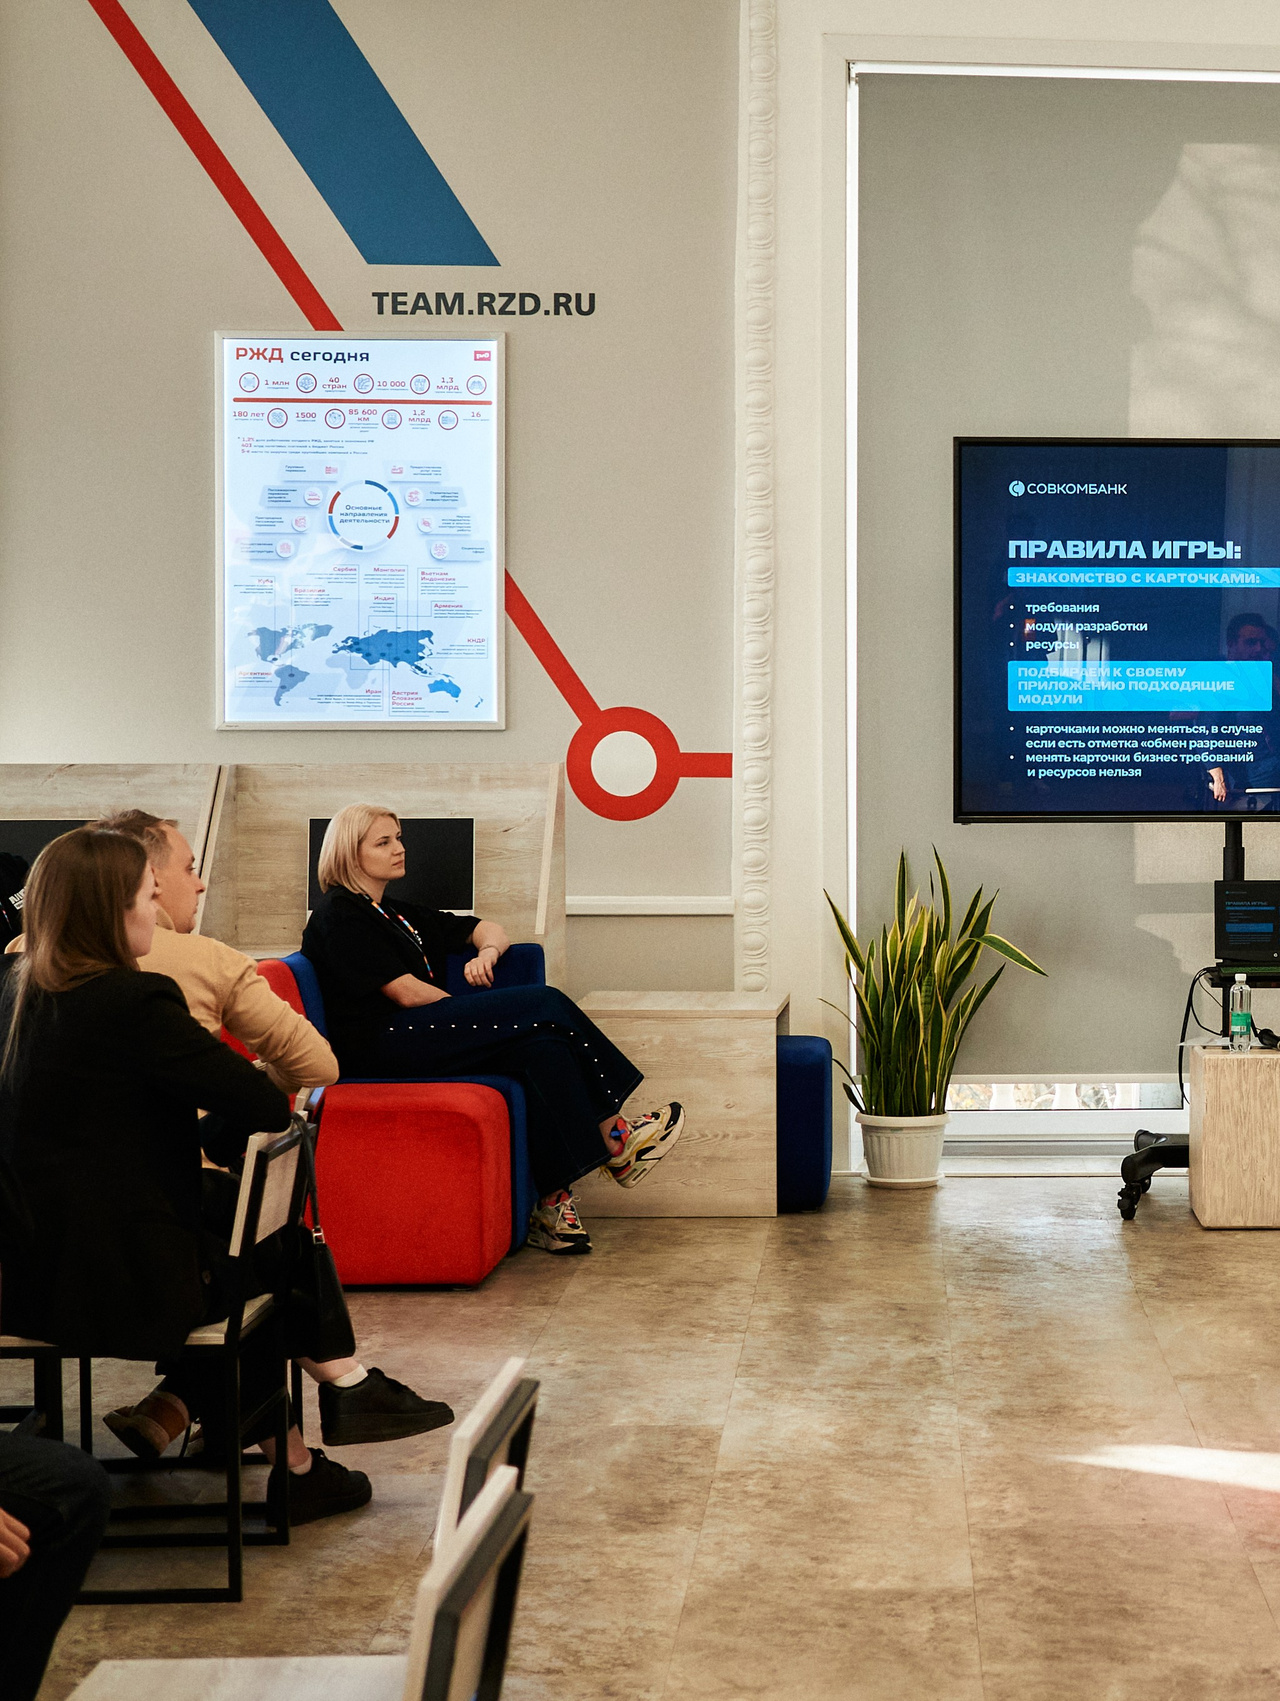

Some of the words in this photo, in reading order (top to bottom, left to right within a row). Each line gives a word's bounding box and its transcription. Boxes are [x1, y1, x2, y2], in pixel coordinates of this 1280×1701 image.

[371, 291, 596, 316] TEAM.RZD.RU
[235, 347, 284, 363] РЖД
[290, 351, 369, 364] сегодня
[1027, 483, 1128, 495] СОВКОМБАНК
[1008, 540, 1147, 559] ПРАВИЛА
[1152, 540, 1241, 560] ИГРЫ:
[1015, 572, 1127, 584] ЗНАКОМСТВО
[1130, 572, 1142, 584] С
[1145, 572, 1261, 584] КАРТОЧКАМИ:
[1025, 602, 1100, 614] требования
[1025, 621, 1074, 633] модули
[1075, 620, 1148, 633] разработки
[1025, 640, 1080, 652] ресурсы
[1018, 667, 1110, 679] ПОДБИРАЕМ
[1113, 667, 1122, 678] К
[1125, 667, 1187, 678] СВОЕМУ
[1018, 680, 1126, 691] ПРИЛОЖЕНИЮ
[1128, 681, 1235, 692] ПОДХОДЯЩИЕ
[1018, 694, 1083, 705] МОДУЛИ
[1025, 725, 1100, 737] карточками
[1102, 725, 1145, 734] можно
[1147, 725, 1209, 736] меняться,
[1211, 725, 1219, 734] в
[1220, 725, 1263, 737] случае
[1025, 739, 1056, 748] если
[1058, 739, 1086, 748] есть
[1087, 739, 1138, 748] отметка
[1140, 738, 1187, 748] «обмен
[1188, 739, 1258, 751] разрешен»
[1025, 753, 1071, 763] менять
[1073, 753, 1131, 765] карточки
[1133, 751, 1178, 763] бизнес
[1179, 751, 1254, 765] требований
[1027, 768, 1036, 777] и
[1038, 768, 1096, 779] ресурсов
[1099, 768, 1142, 777] нельзя
